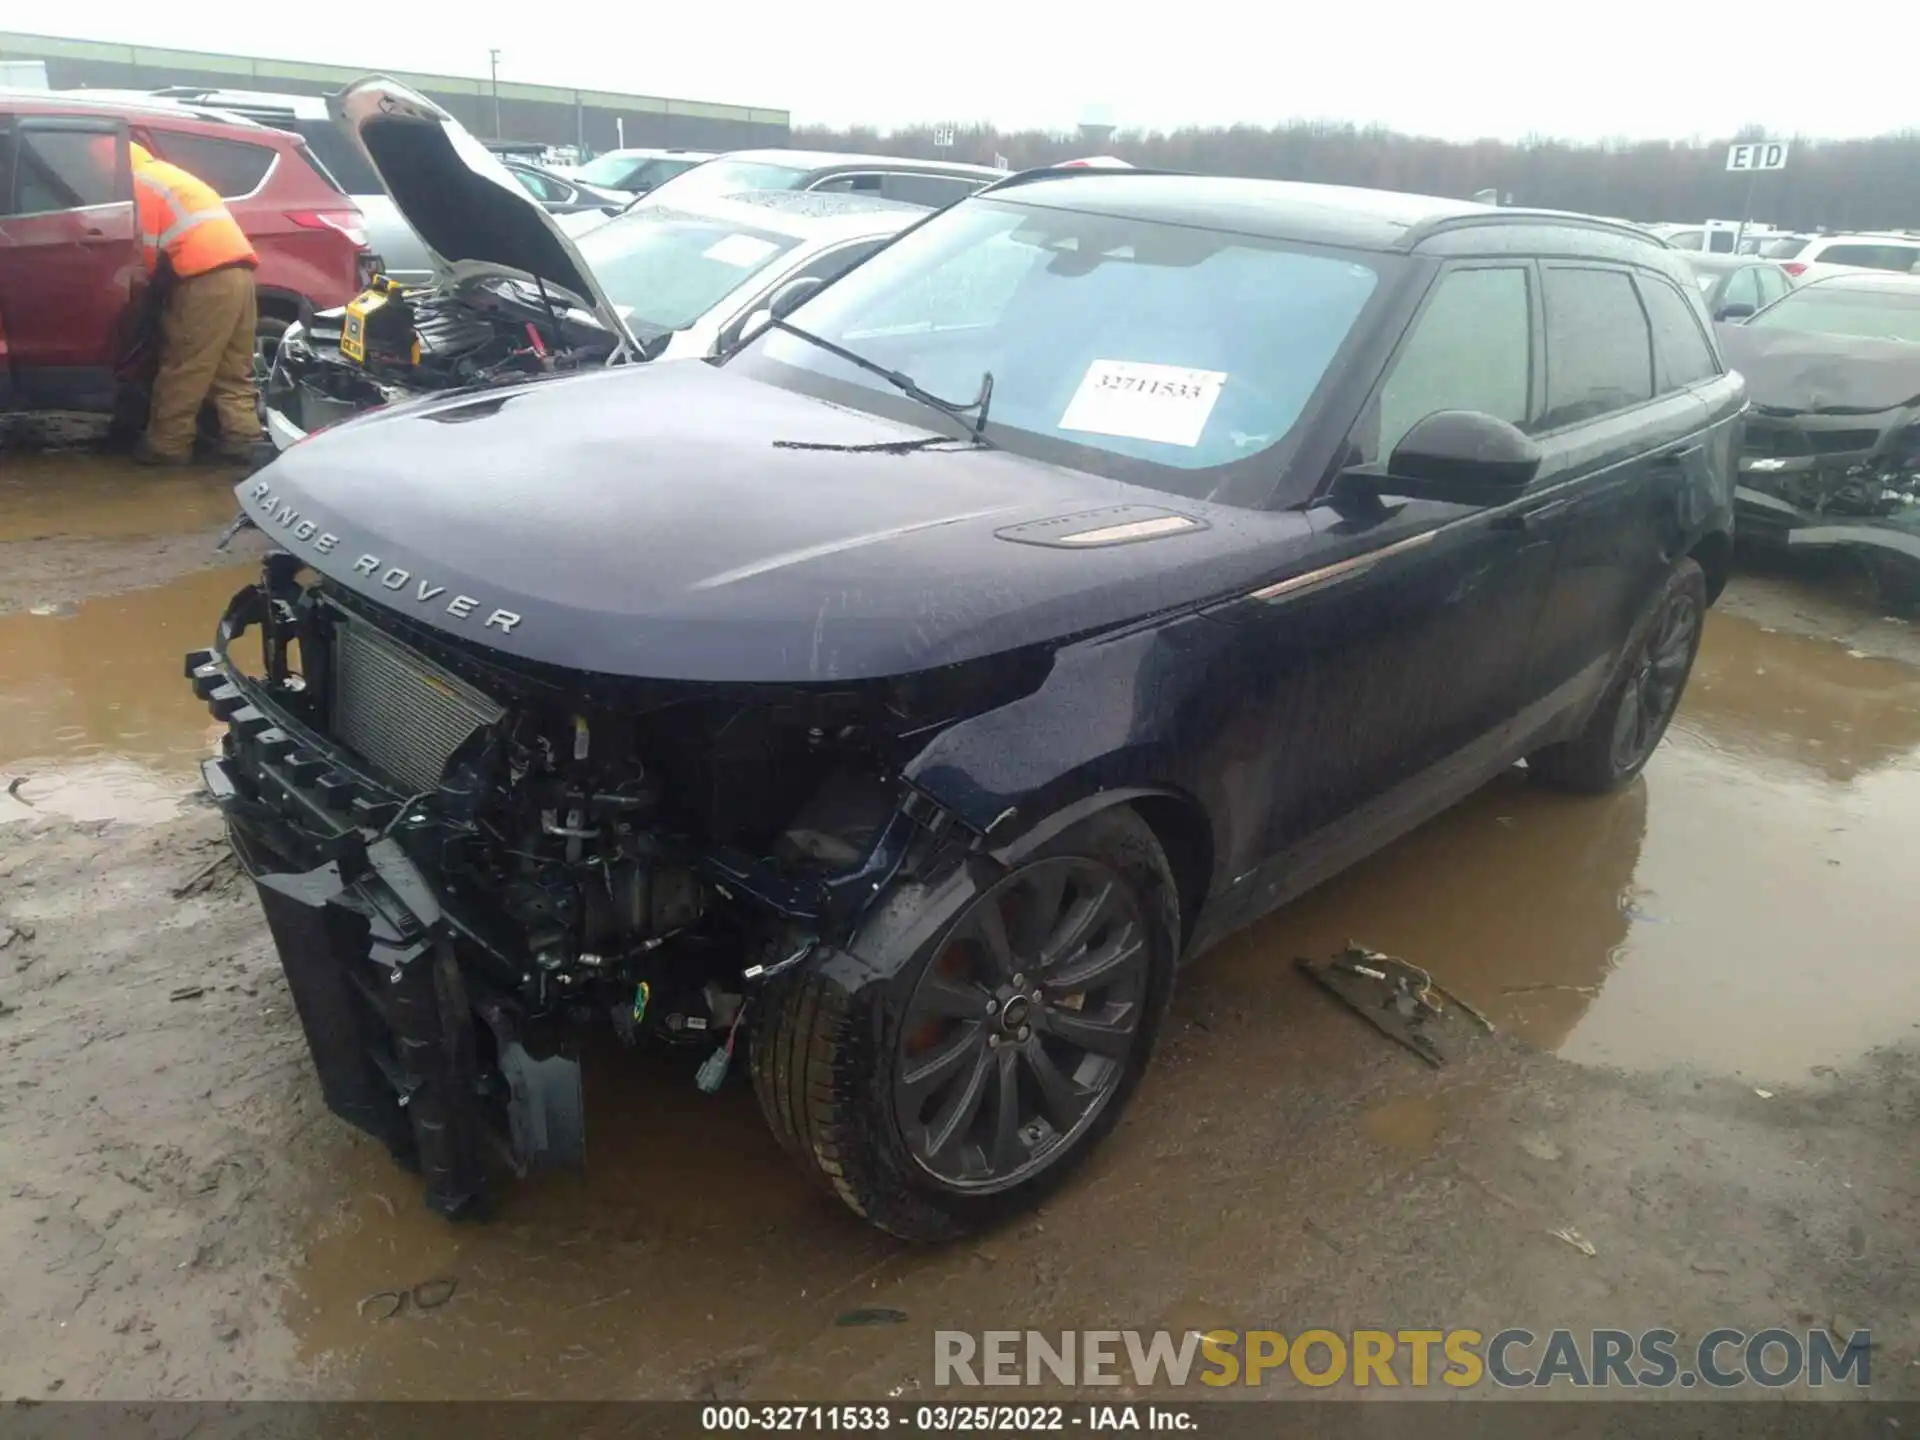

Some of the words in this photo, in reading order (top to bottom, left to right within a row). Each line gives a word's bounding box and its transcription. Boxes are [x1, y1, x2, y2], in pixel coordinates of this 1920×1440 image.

[1096, 374, 1202, 399] 32711533
[249, 481, 340, 554] RANGE
[353, 554, 522, 634] ROVER
